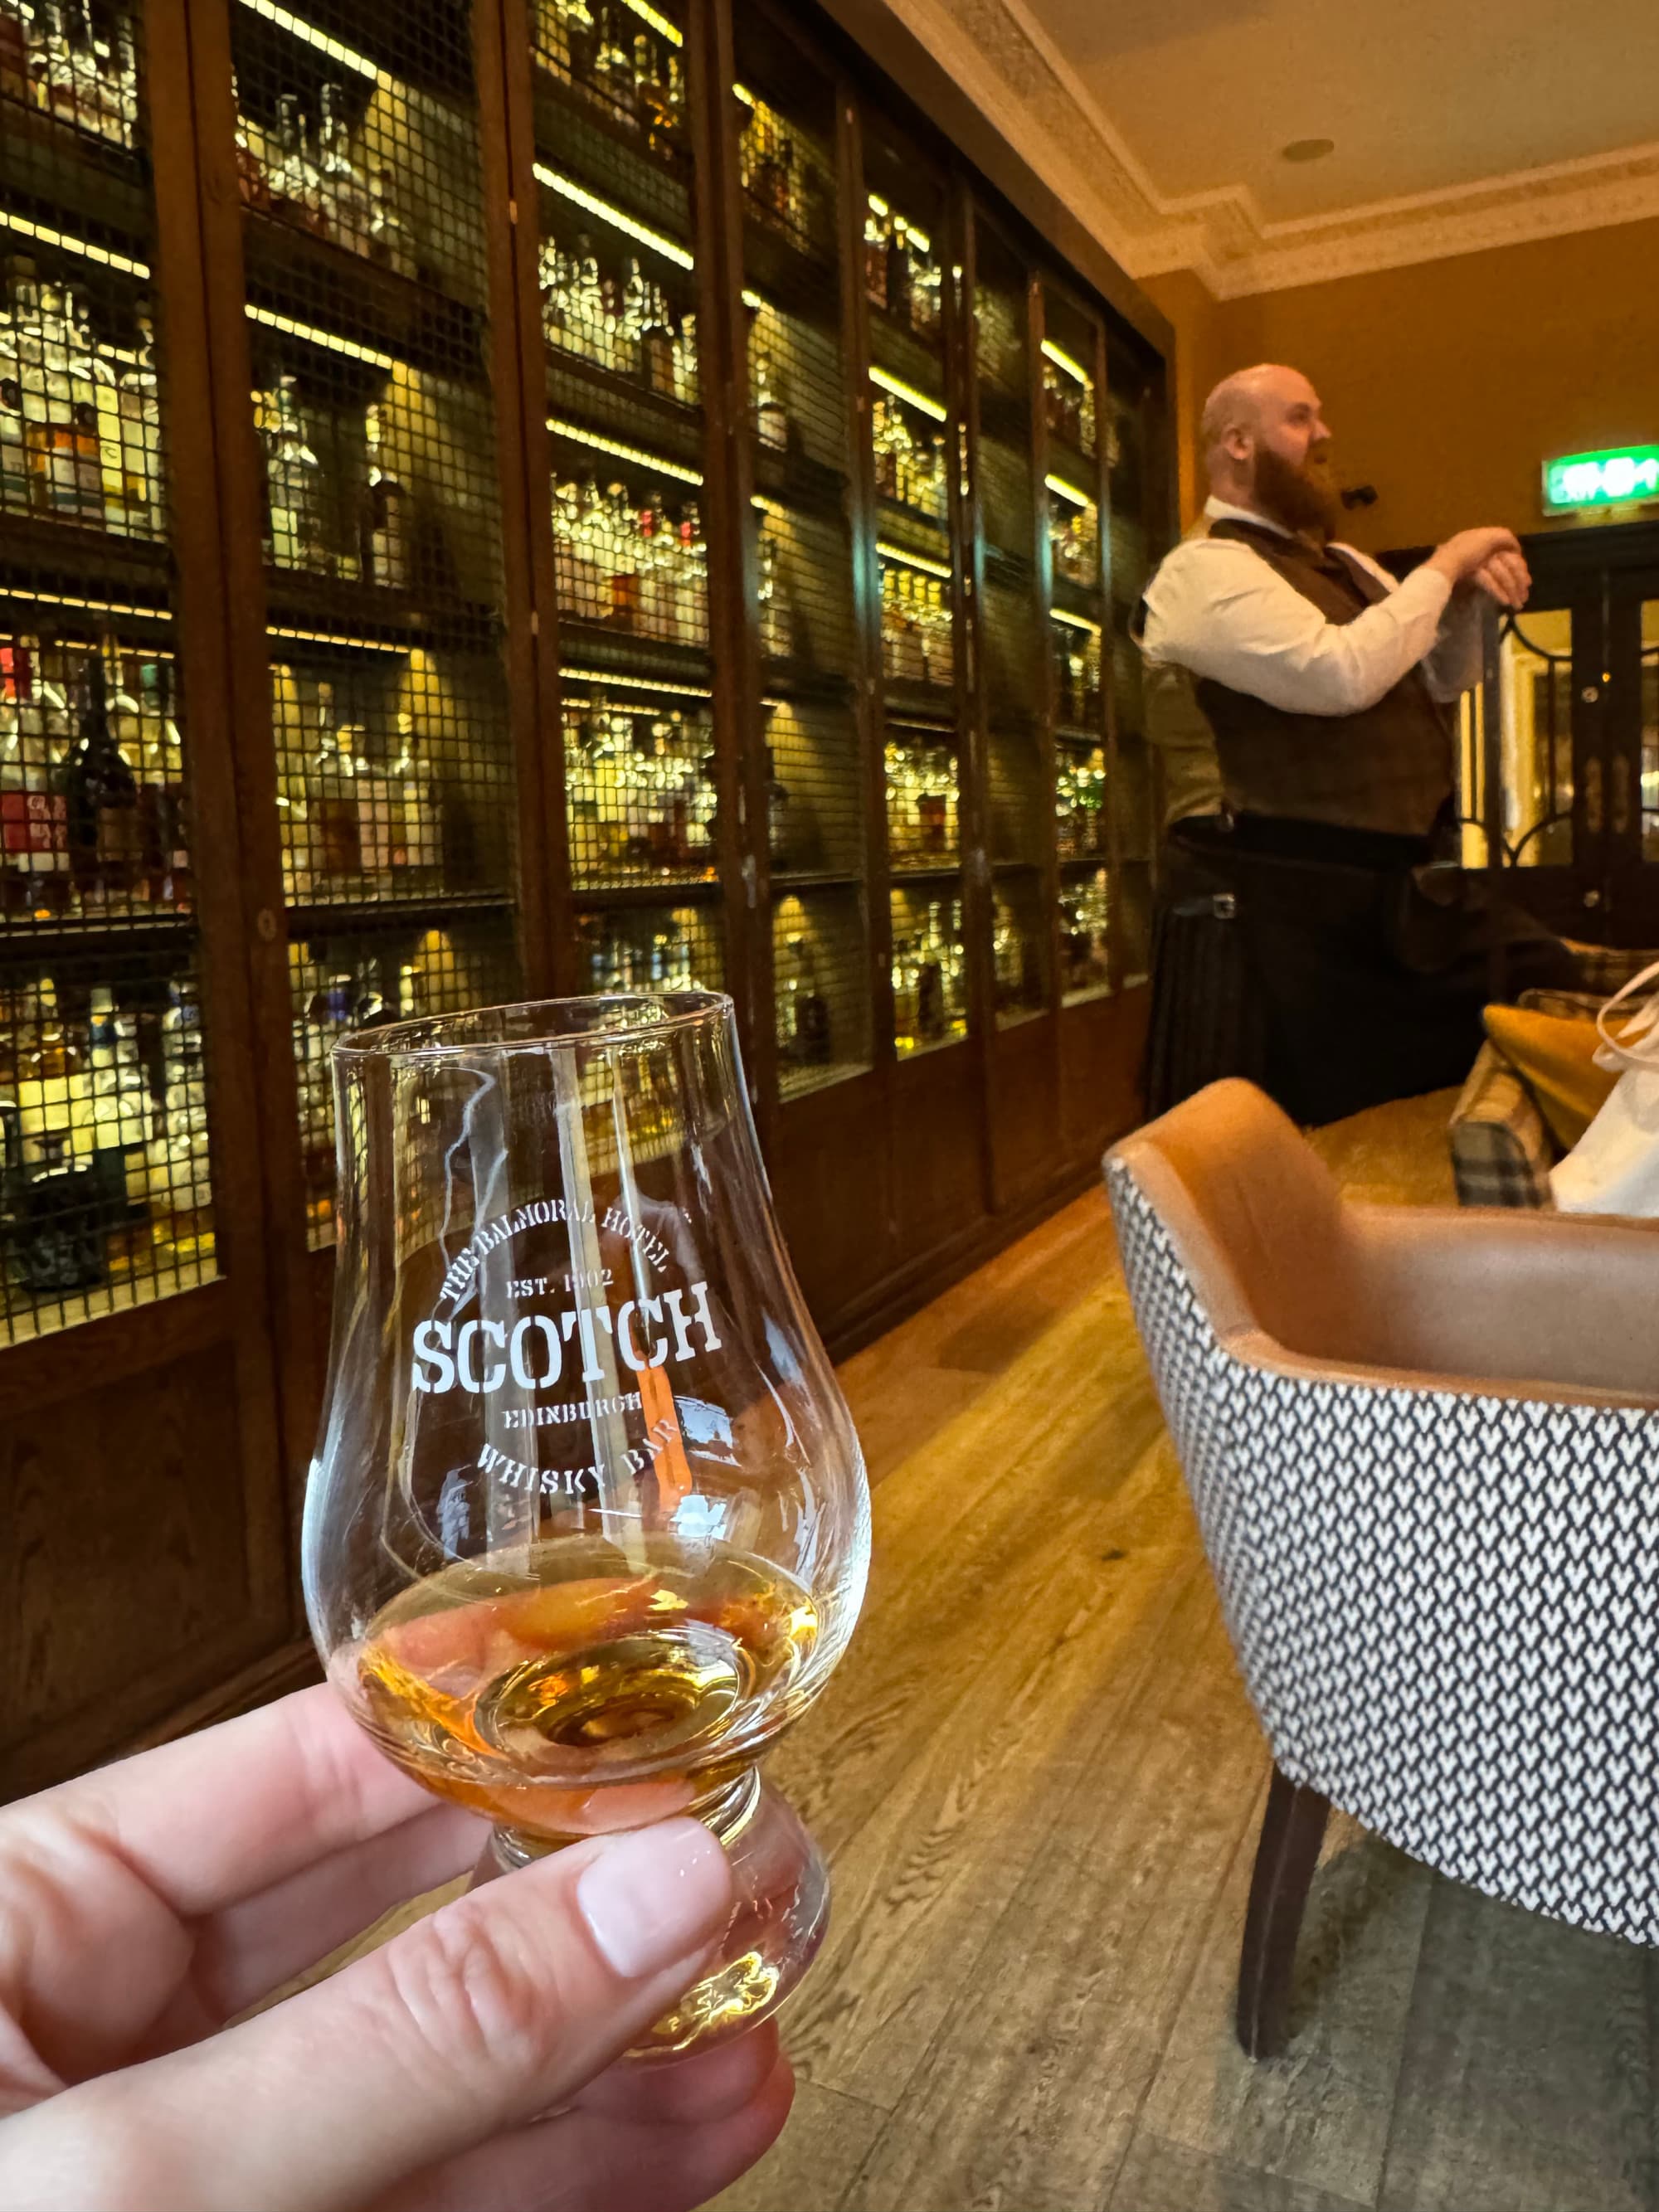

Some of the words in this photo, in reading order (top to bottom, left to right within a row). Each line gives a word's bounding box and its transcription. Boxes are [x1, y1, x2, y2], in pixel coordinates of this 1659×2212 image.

[440, 1247, 479, 1301] THE
[474, 1199, 596, 1255] BALMORAL
[601, 1208, 669, 1273] HOTEL
[506, 1277, 555, 1299] EST.
[412, 1281, 722, 1394] SCOTCH
[501, 1392, 642, 1429] EDINBURGH
[477, 1443, 606, 1495] WHISKY
[620, 1419, 678, 1475] BAR
